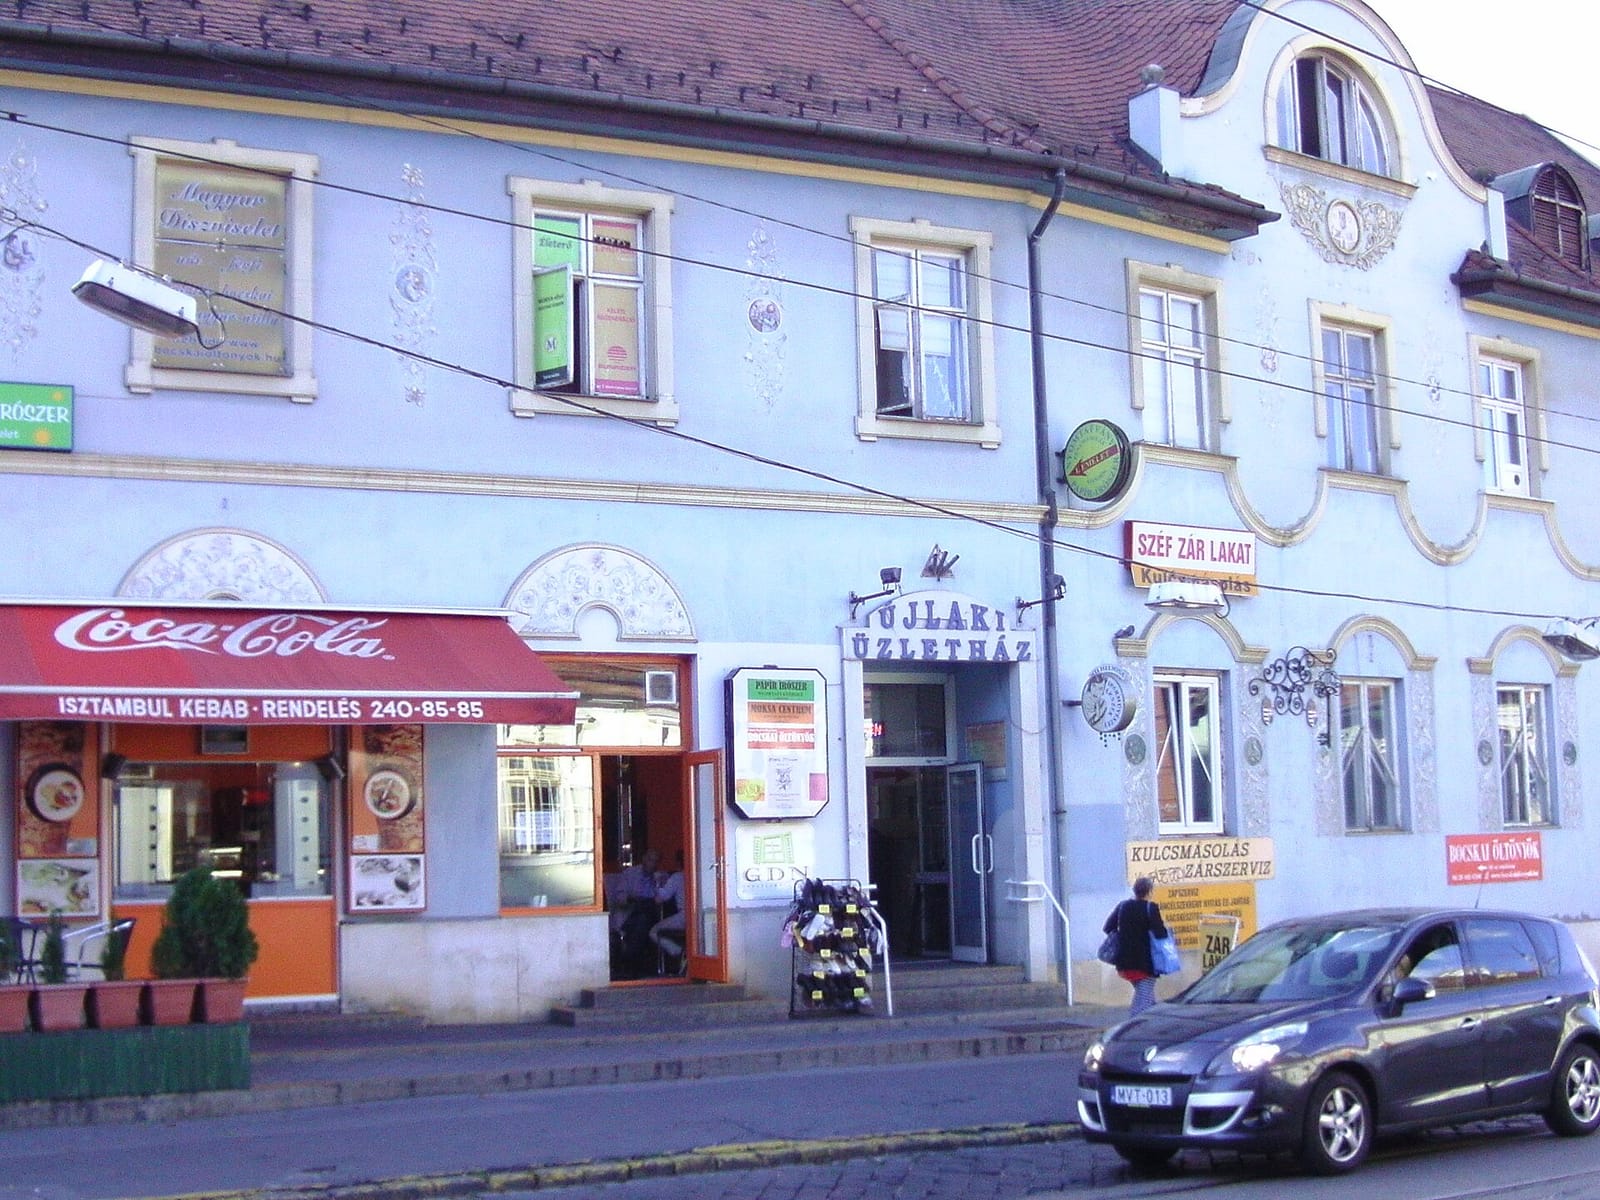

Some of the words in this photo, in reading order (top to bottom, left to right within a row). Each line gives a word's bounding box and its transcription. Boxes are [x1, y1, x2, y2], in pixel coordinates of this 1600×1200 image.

[169, 182, 266, 212] Magyar
[1138, 530, 1172, 558] SZÉF
[1178, 533, 1205, 561] ZÁR
[1210, 540, 1251, 565] LAKAT
[879, 599, 1005, 631] ÚJLAKI
[54, 607, 388, 657] Coca-Cola
[852, 633, 1031, 661] ÜZLETHÁZ
[58, 697, 173, 718] ISZTAMBUL
[179, 698, 249, 718] KEBAB
[262, 696, 361, 718] RENDELÉS
[370, 700, 484, 718] 240-85-85
[1132, 839, 1249, 862] KULCSMÁSOLÁS
[1449, 843, 1489, 863] BOCSKAI
[1184, 861, 1271, 879] ZÁRSZERVIZ
[1206, 931, 1230, 953] ZÁR
[1117, 1089, 1168, 1104] MVT-013
